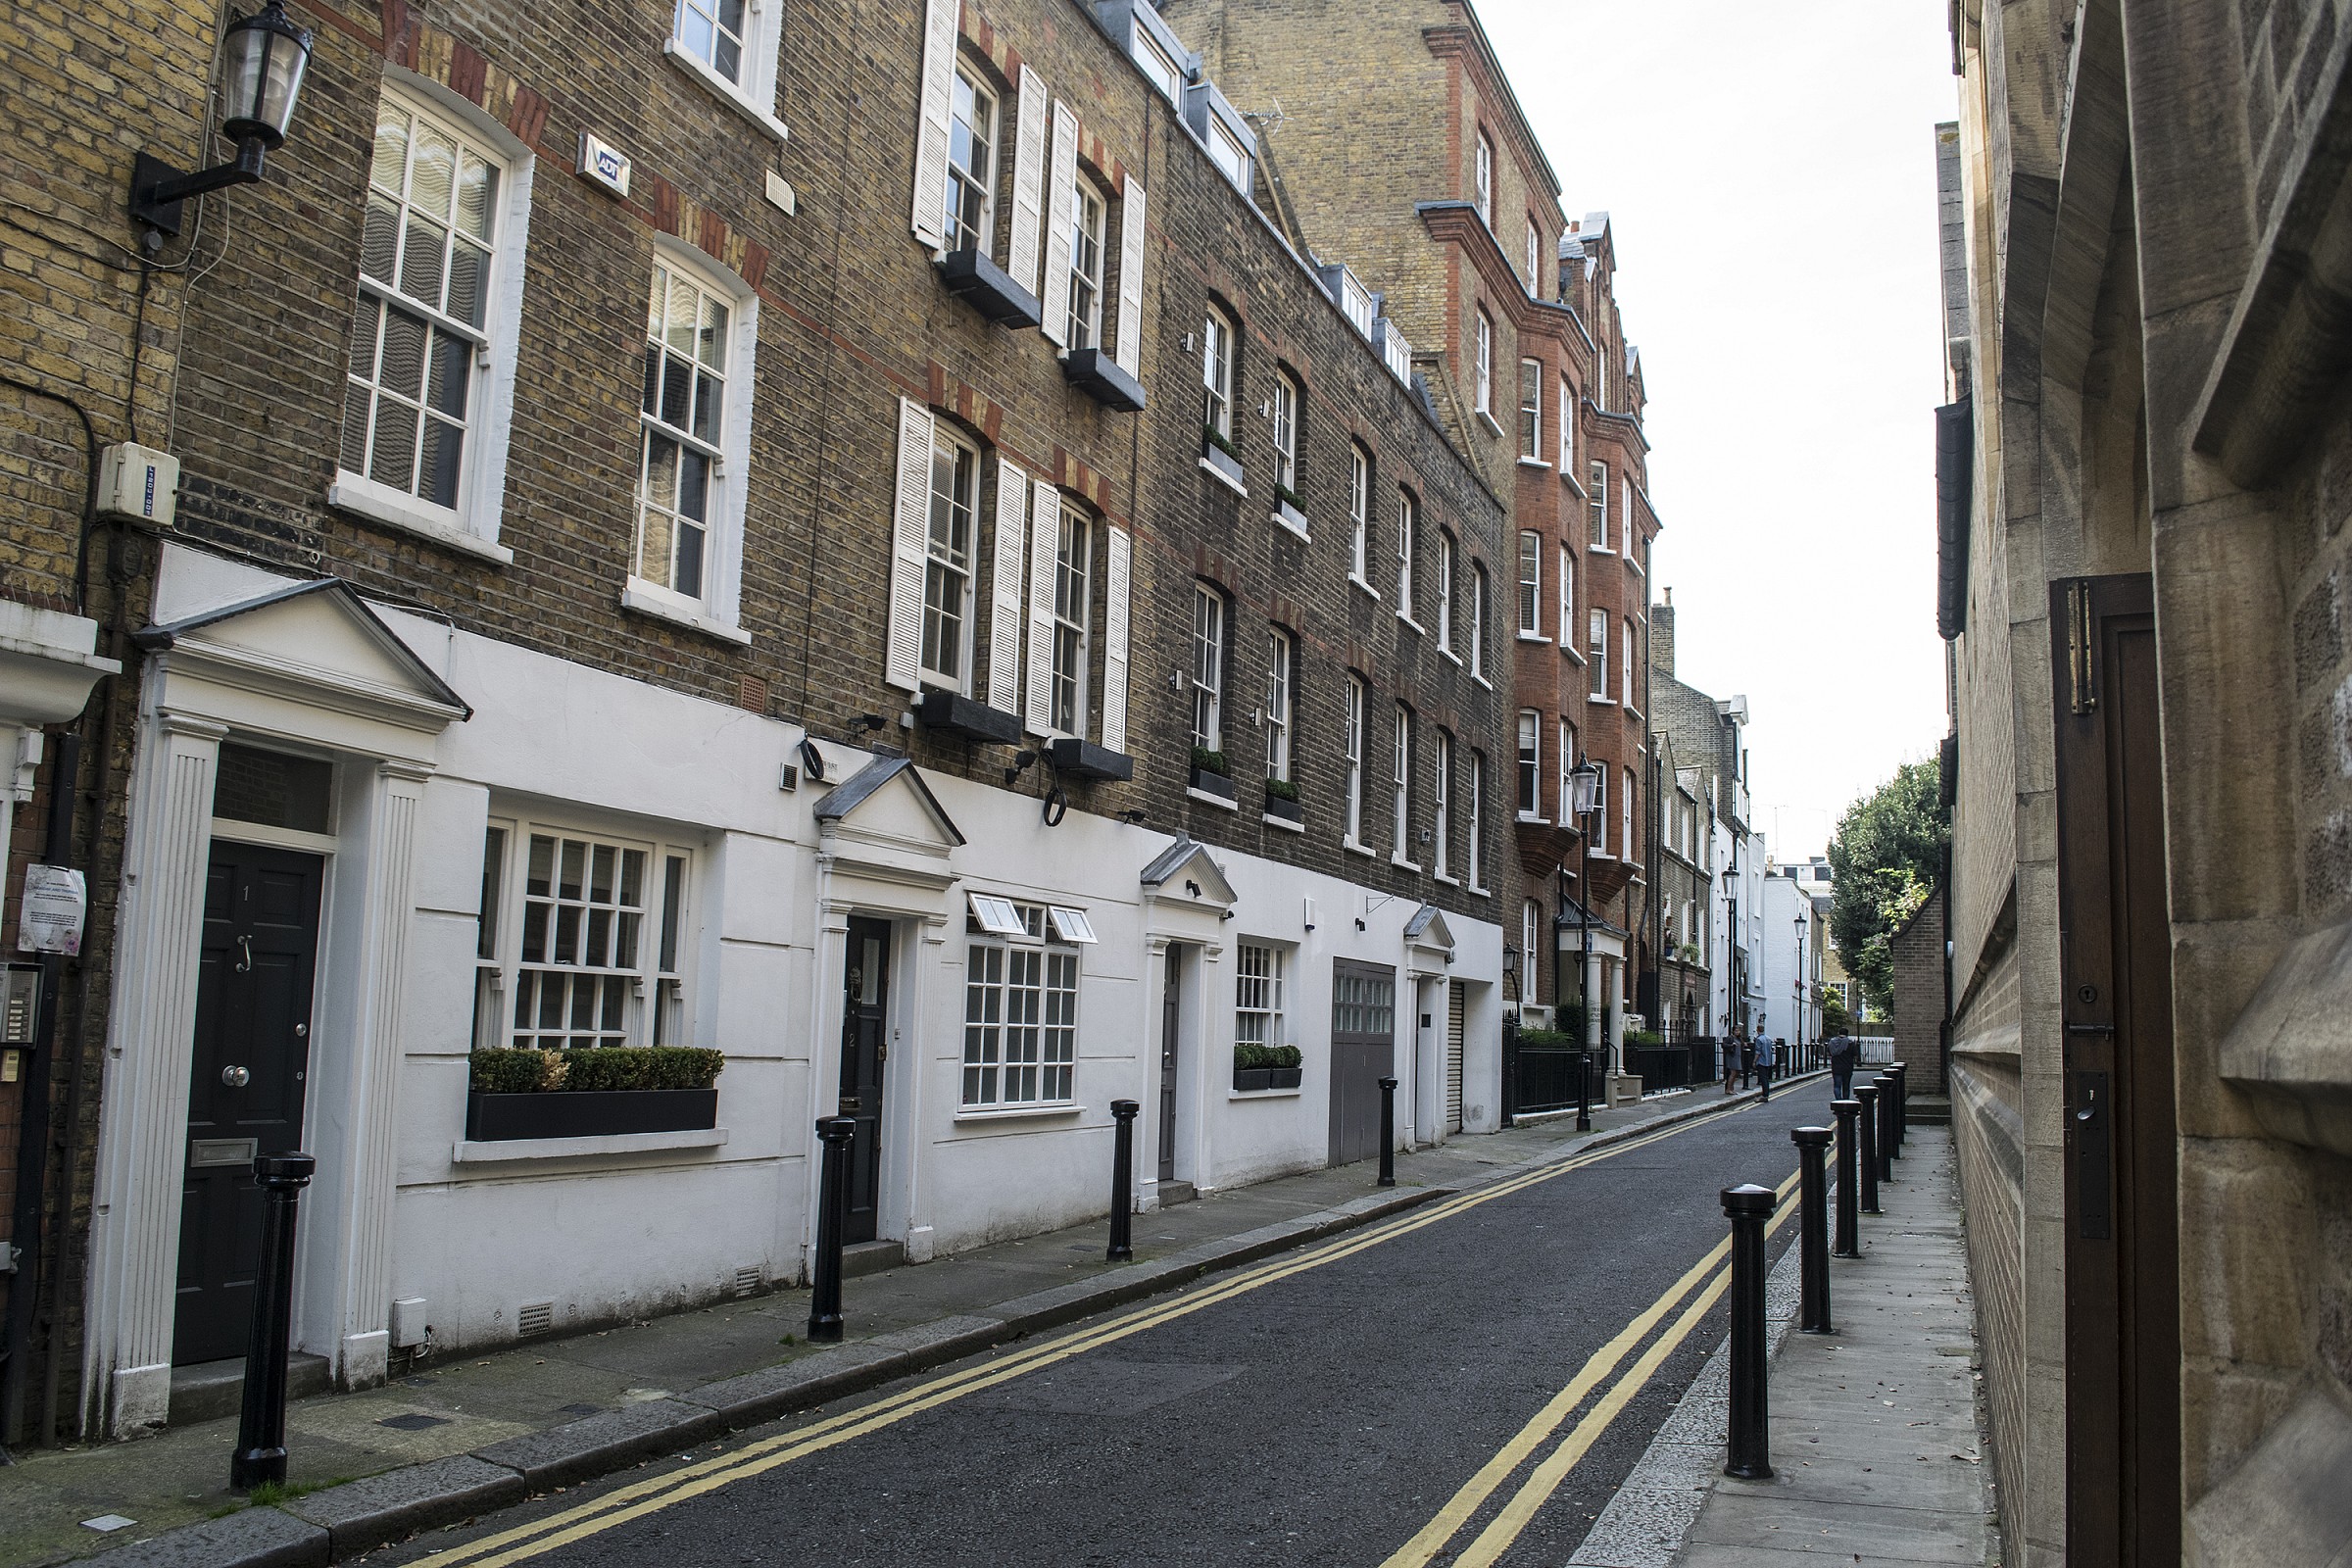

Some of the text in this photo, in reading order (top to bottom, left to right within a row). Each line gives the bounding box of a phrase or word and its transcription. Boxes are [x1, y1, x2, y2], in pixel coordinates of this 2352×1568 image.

[598, 157, 617, 176] ADT
[243, 885, 249, 902] 1
[849, 1033, 855, 1047] 2
